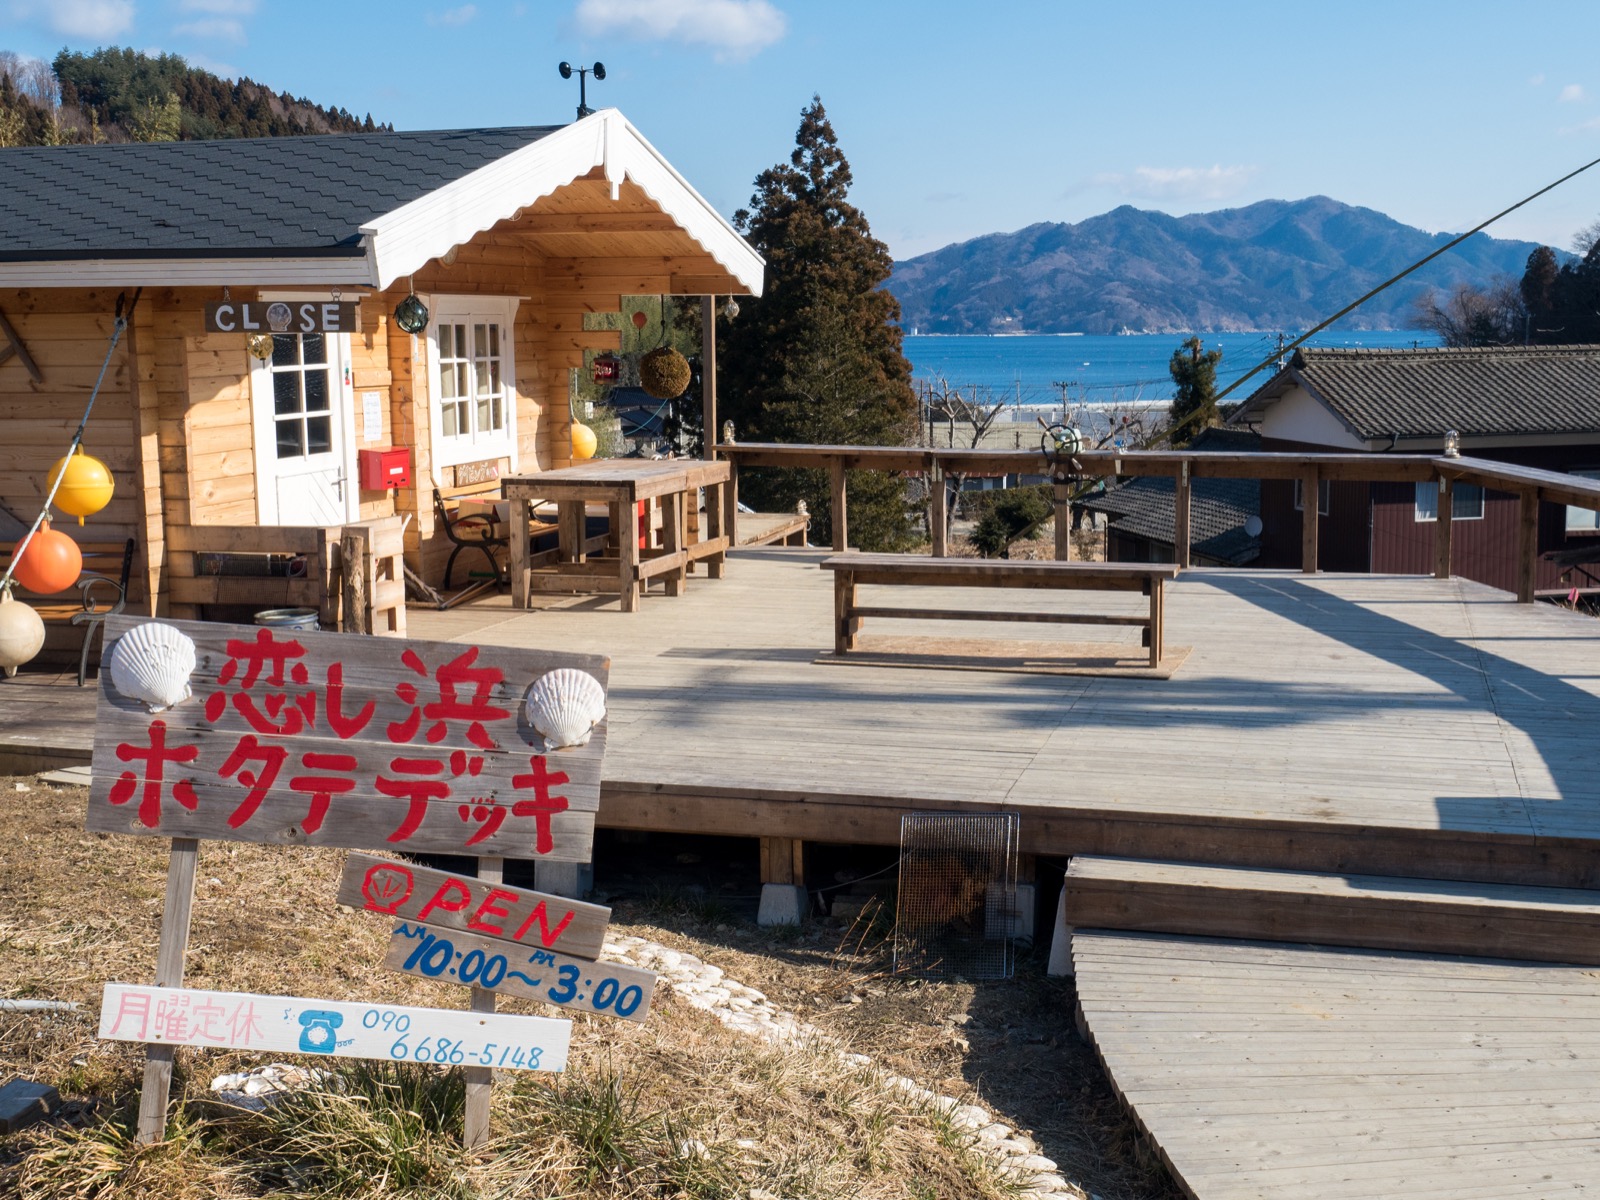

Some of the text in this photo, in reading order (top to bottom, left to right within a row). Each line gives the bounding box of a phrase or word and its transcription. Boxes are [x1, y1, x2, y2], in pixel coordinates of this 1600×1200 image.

[205, 628, 510, 749] 恋し浜
[108, 720, 569, 854] ホタテデッキ
[109, 992, 264, 1046] 月曜定休
[362, 1009, 411, 1033] 090
[390, 1033, 544, 1070] 6686-5148
